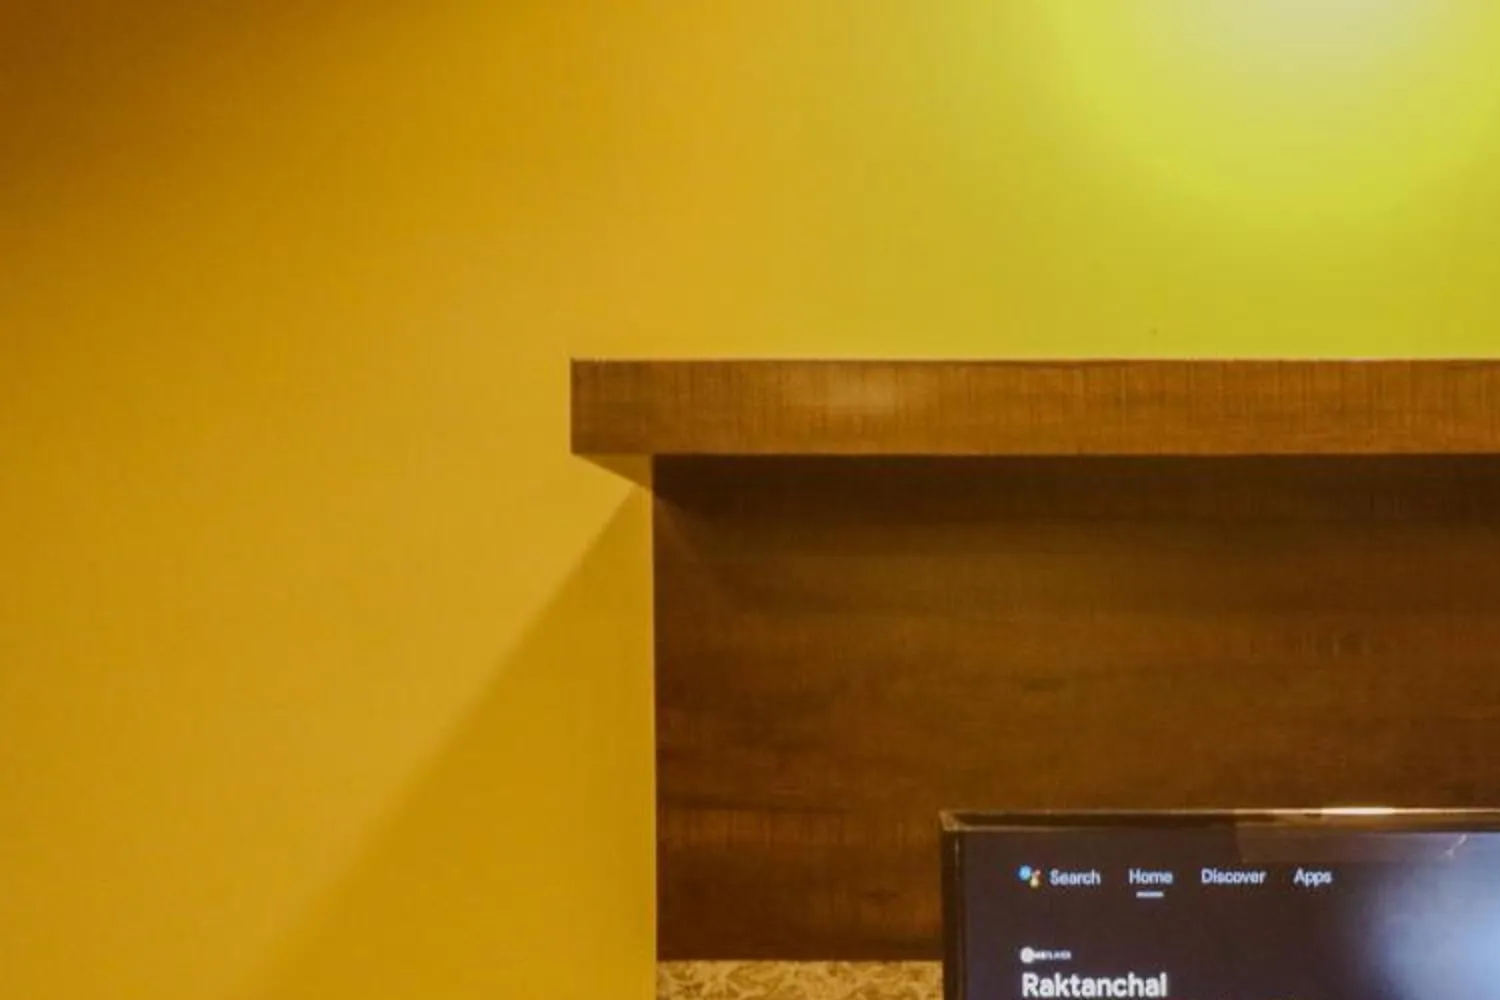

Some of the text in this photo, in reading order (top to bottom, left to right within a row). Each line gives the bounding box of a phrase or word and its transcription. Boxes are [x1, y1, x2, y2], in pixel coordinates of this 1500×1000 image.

[1050, 868, 1333, 887] Search Home Discover Apps
[1022, 972, 1168, 998] Raktanchal
